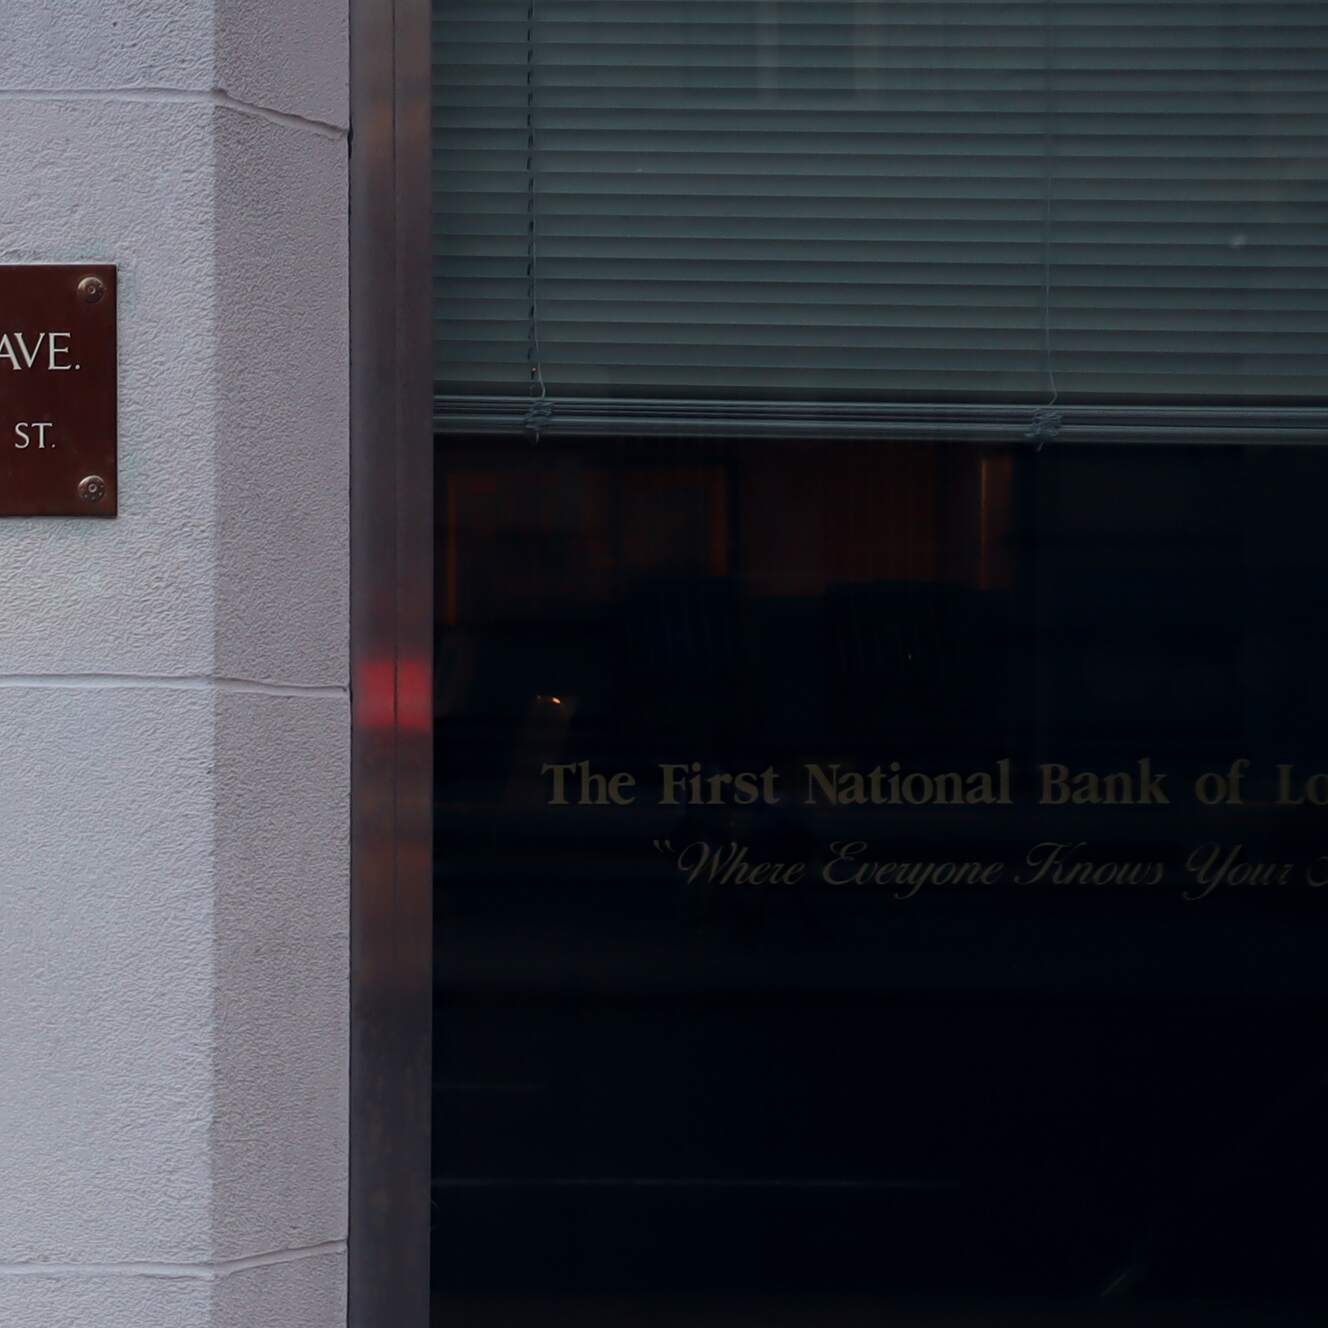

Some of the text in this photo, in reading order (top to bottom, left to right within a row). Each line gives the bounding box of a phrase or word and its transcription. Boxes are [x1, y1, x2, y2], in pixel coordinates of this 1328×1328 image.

[15, 422, 57, 449] ST.
[541, 759, 637, 806] The
[658, 761, 781, 805] First
[803, 758, 1014, 806] National
[1038, 757, 1171, 805] Bank
[1195, 758, 1250, 806] of
[822, 840, 1004, 900] Everyone
[1013, 841, 1164, 887] Knows
[1181, 841, 1294, 901] Your
